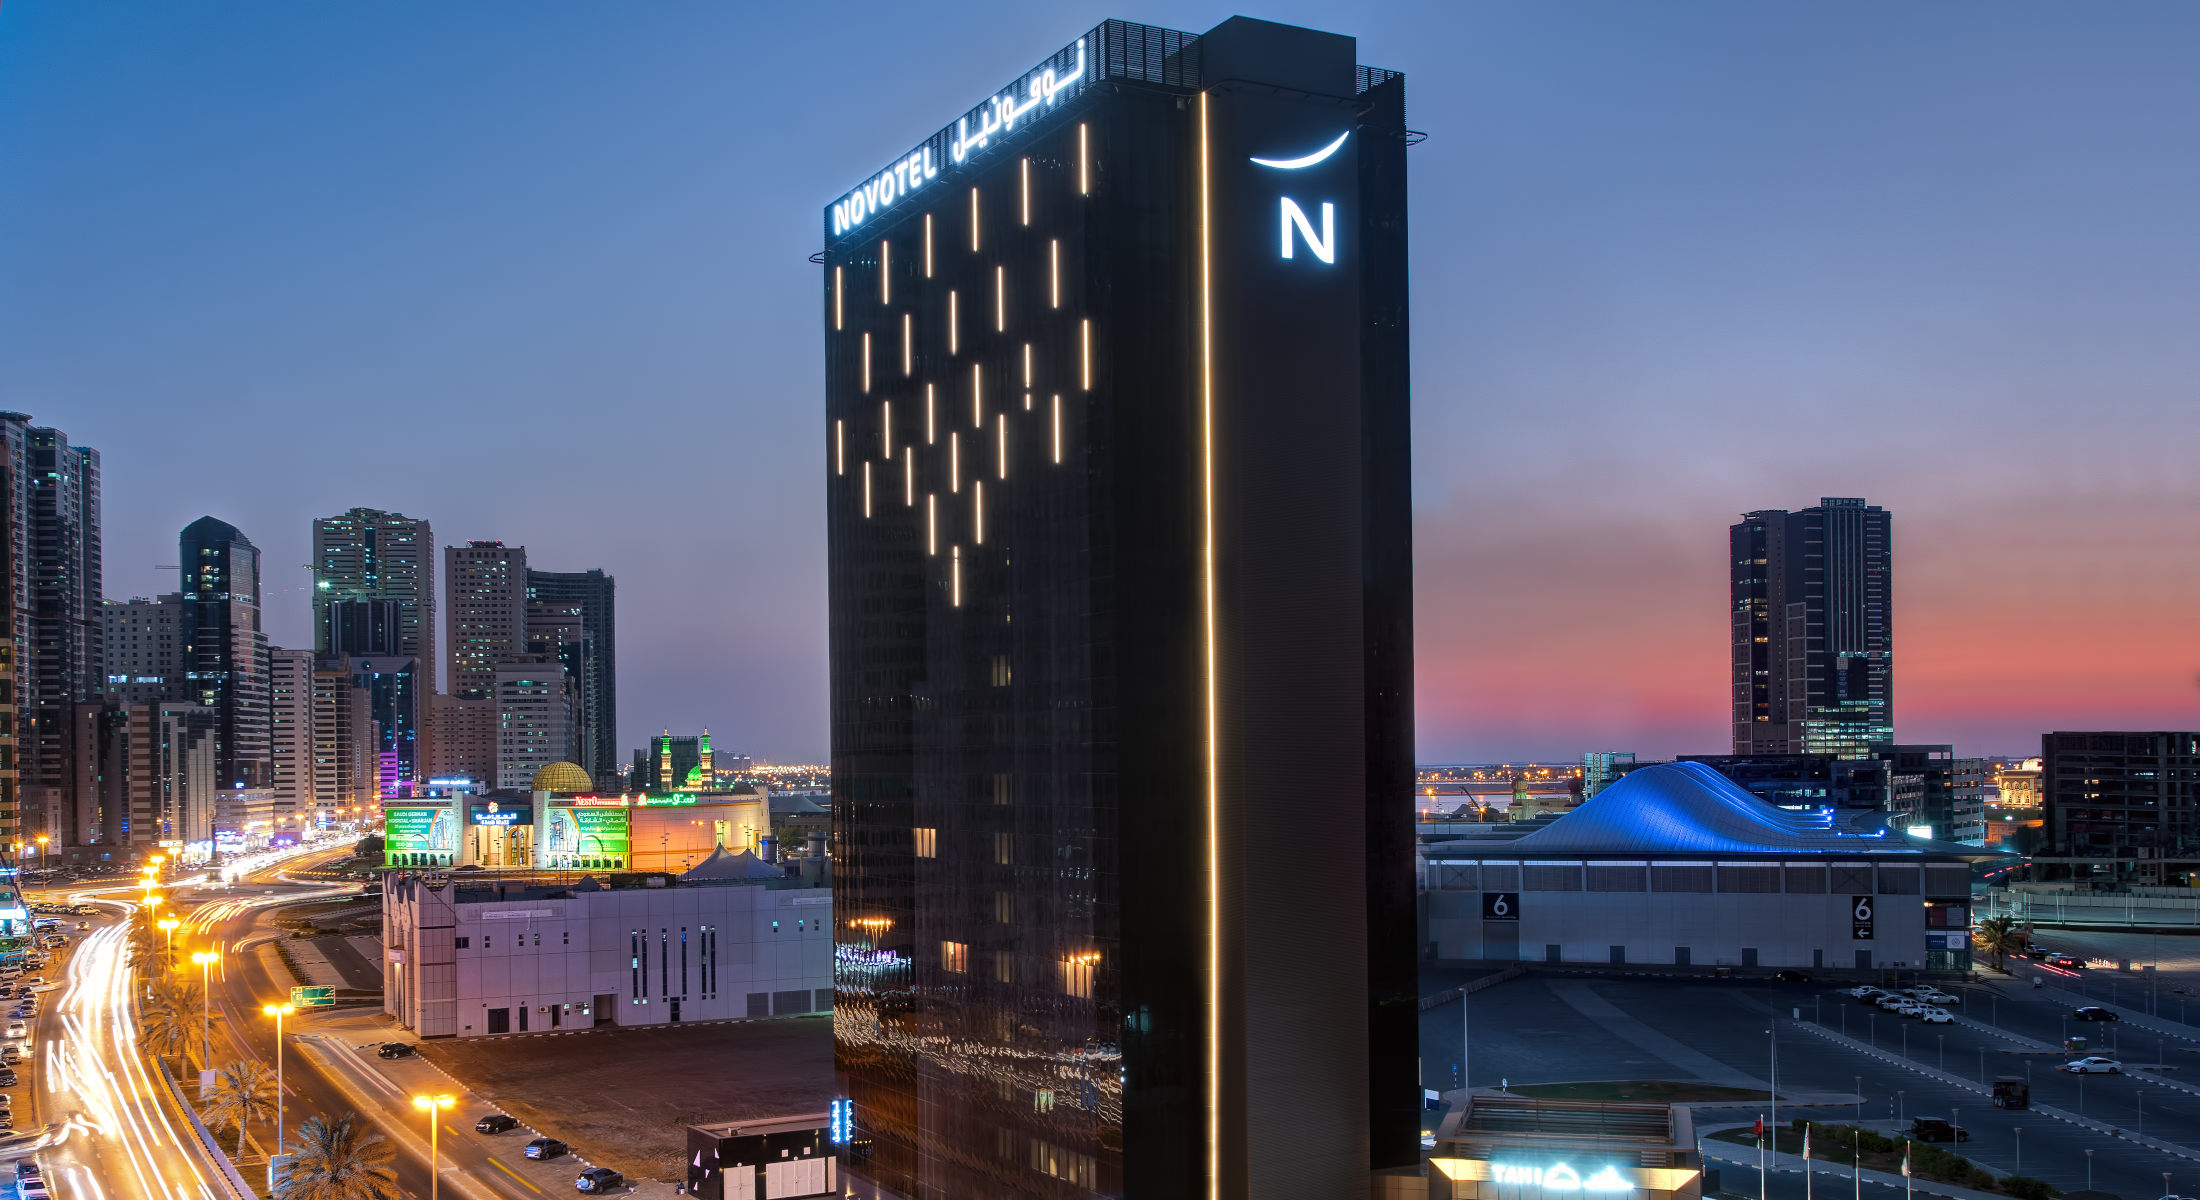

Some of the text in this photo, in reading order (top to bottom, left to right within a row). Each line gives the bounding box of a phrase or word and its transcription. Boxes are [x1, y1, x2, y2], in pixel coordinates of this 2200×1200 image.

[833, 146, 937, 236] NOVOTEL
[1280, 196, 1335, 264] N
[1493, 894, 1508, 916] 6
[1855, 897, 1871, 920] 6
[1491, 1165, 1543, 1185] TAHI
